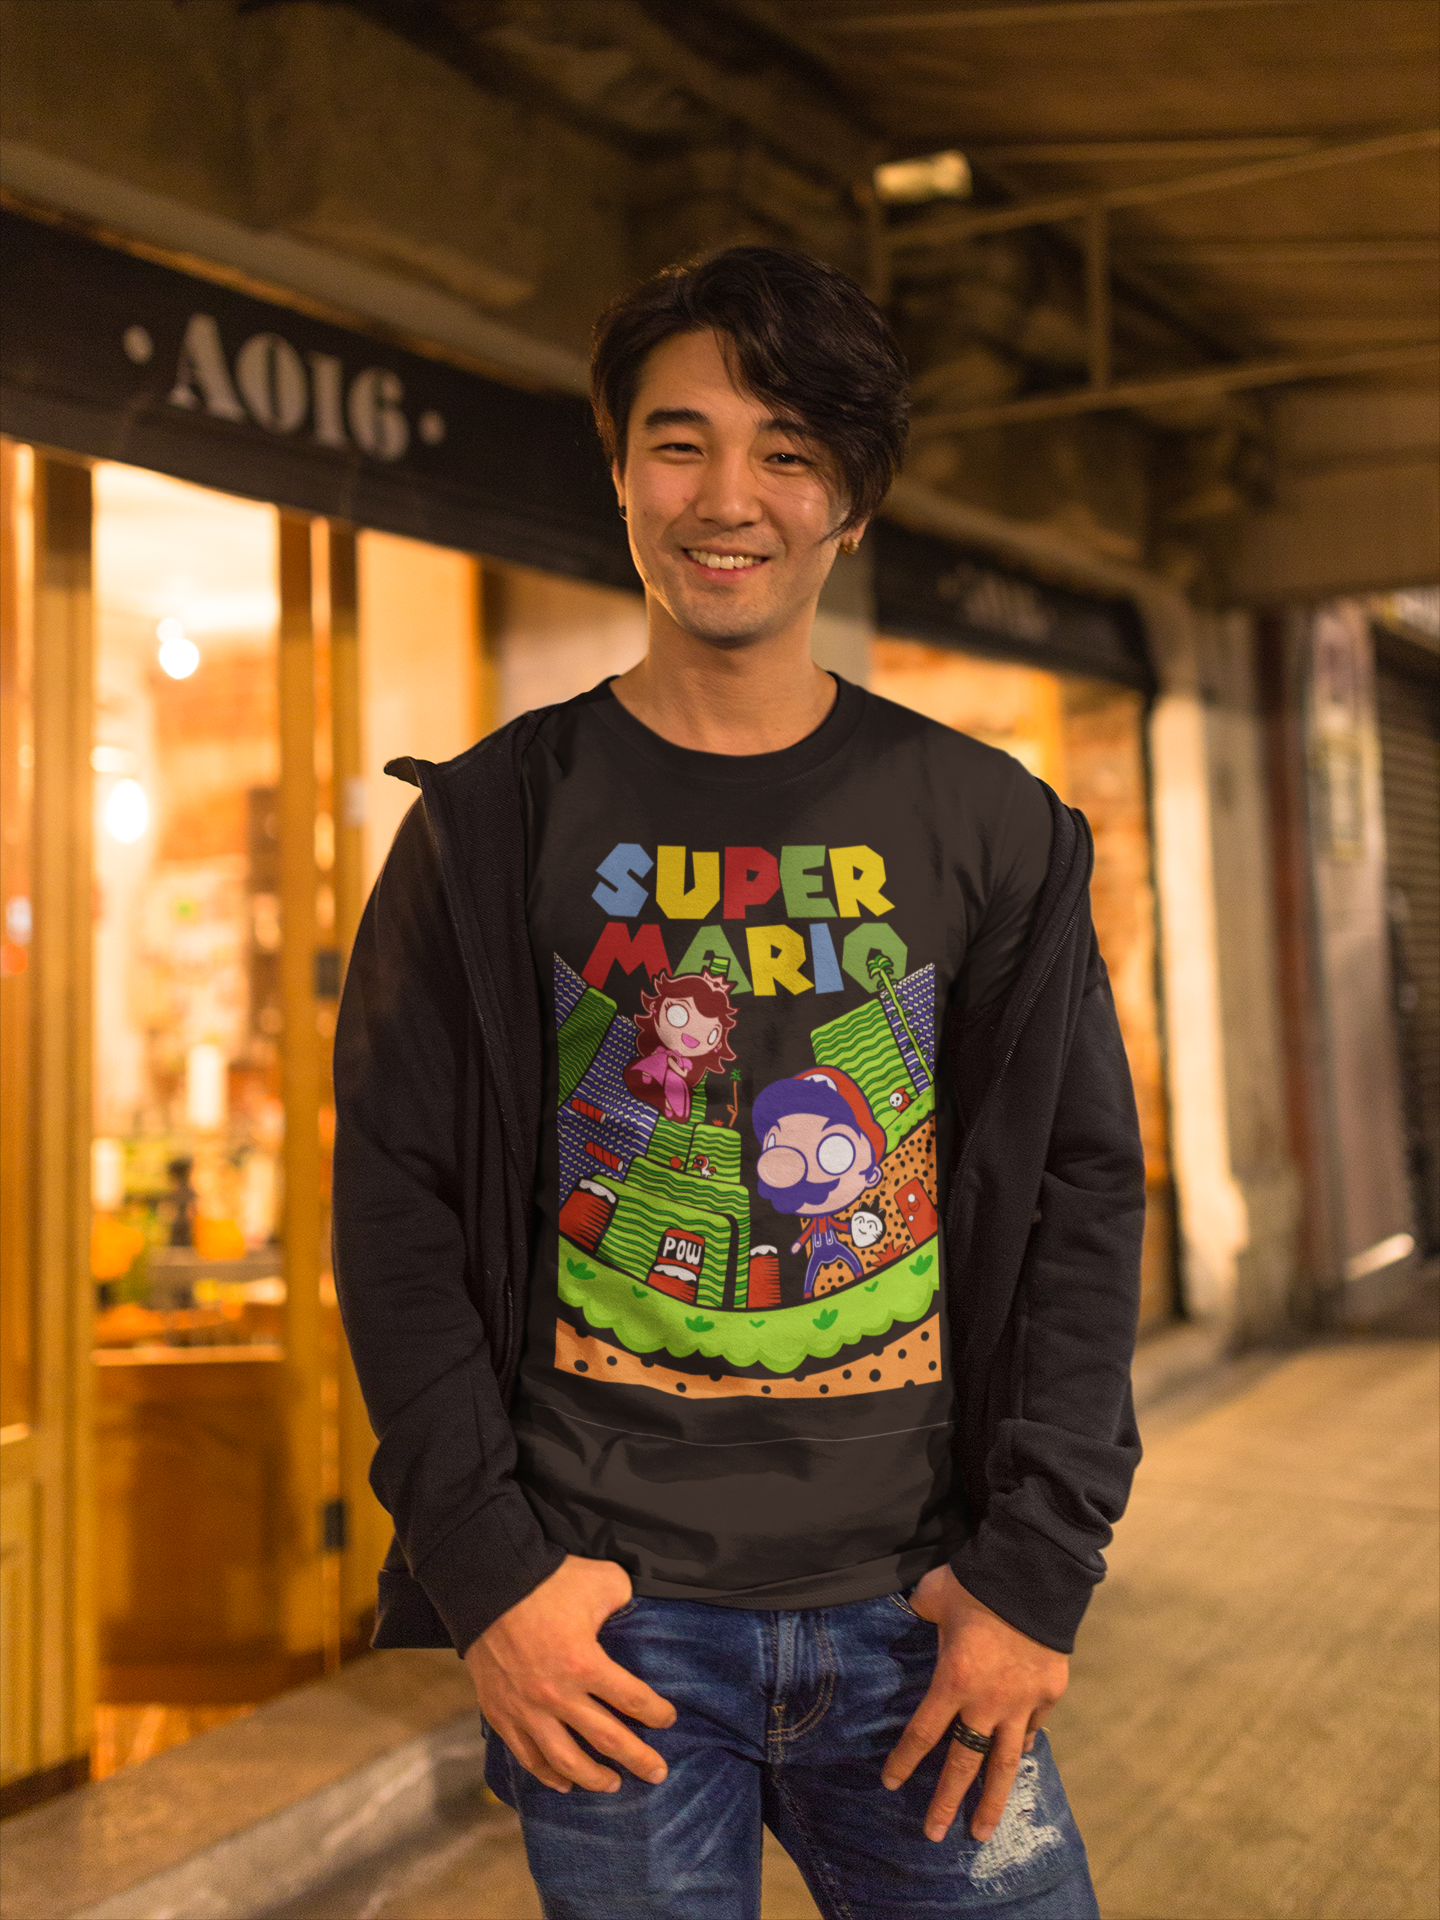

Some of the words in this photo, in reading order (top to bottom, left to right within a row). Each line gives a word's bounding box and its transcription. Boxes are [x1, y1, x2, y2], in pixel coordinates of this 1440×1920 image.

[591, 842, 896, 919] SUPER
[581, 922, 908, 996] MARIO
[662, 1236, 702, 1265] POW
